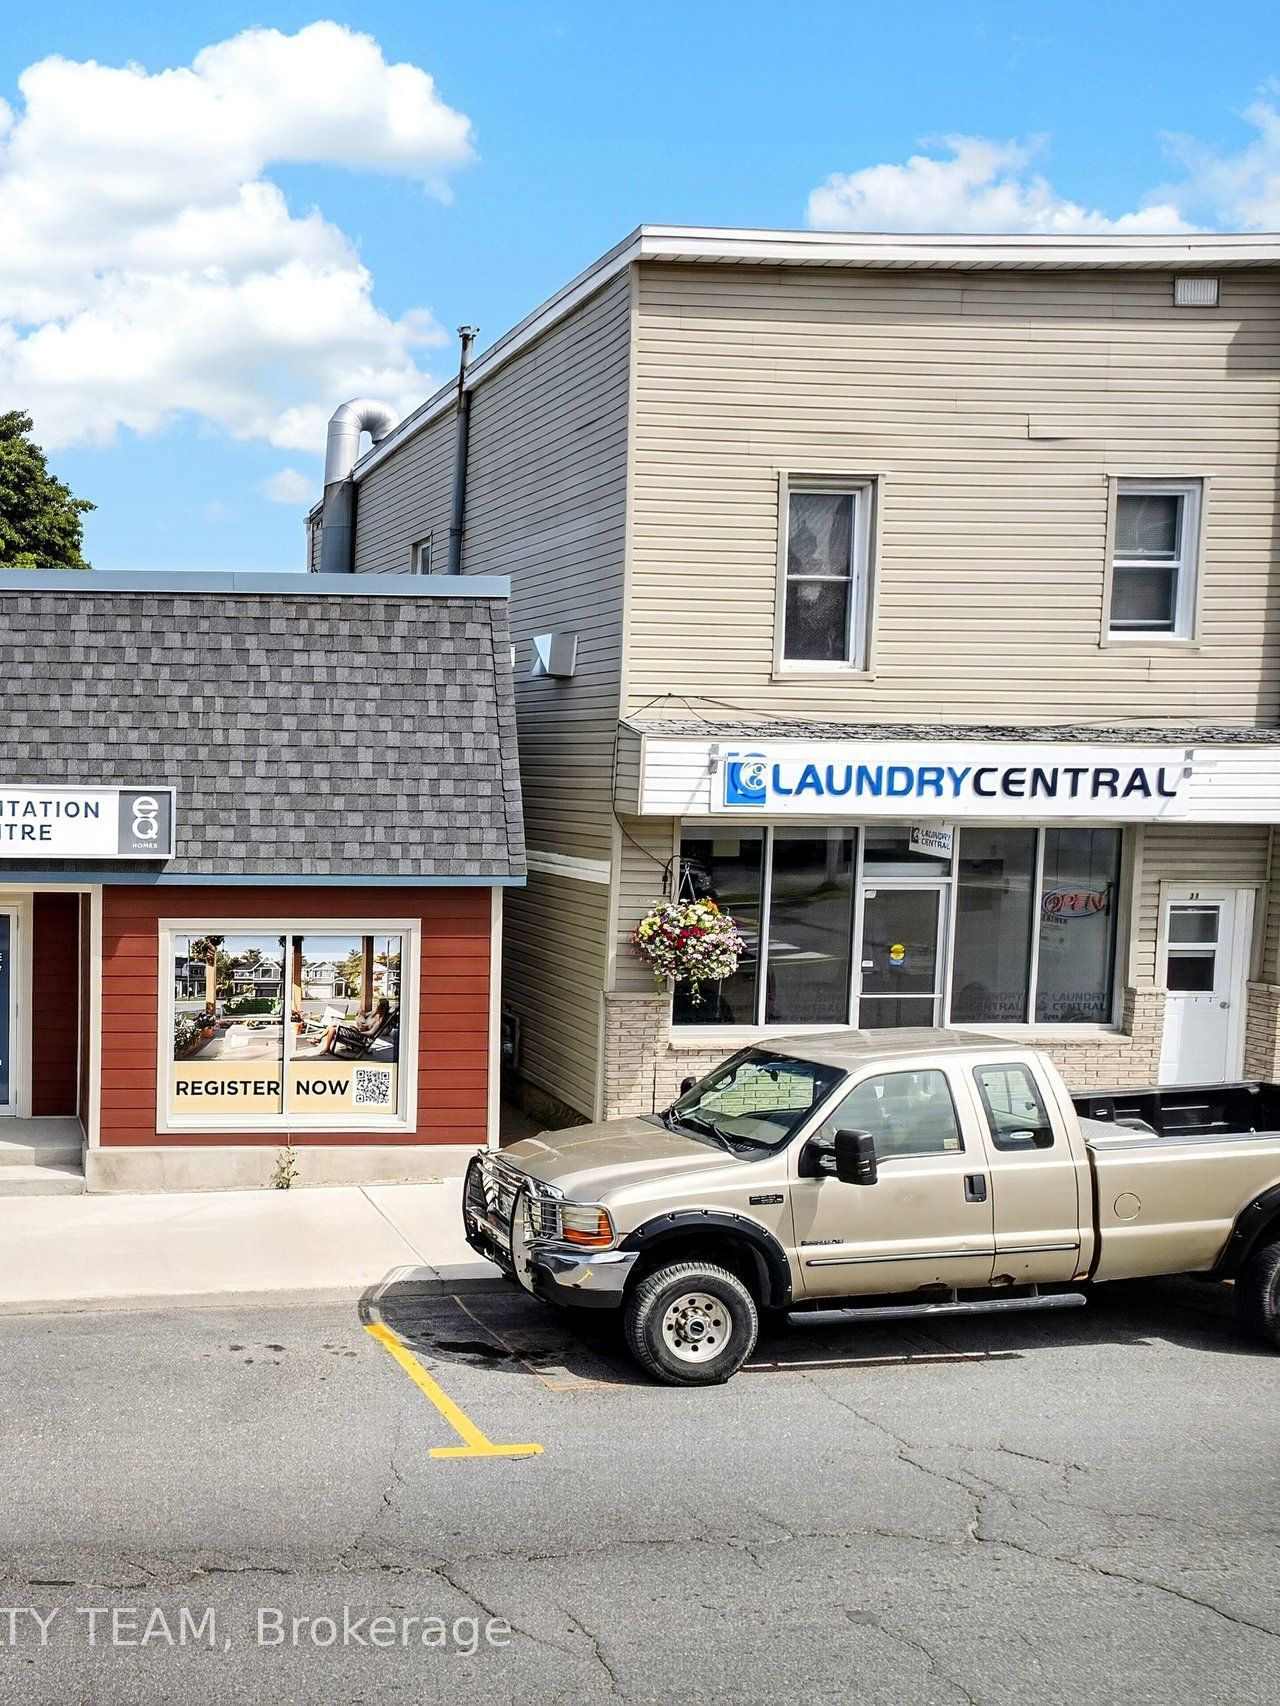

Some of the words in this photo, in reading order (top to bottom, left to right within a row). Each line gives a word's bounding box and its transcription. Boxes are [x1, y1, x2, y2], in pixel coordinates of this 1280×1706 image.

[772, 763, 1177, 798] LAUNDRYCENTRAL
[921, 829, 951, 840] LAUNDRY
[921, 838, 951, 850] CENTRAL
[1046, 891, 1106, 913] OPEN
[1052, 992, 1107, 1002] LAUNDRY
[1052, 1002, 1107, 1011] CENTRAL
[176, 1080, 281, 1096] REGISTER
[296, 1080, 350, 1095] NOW
